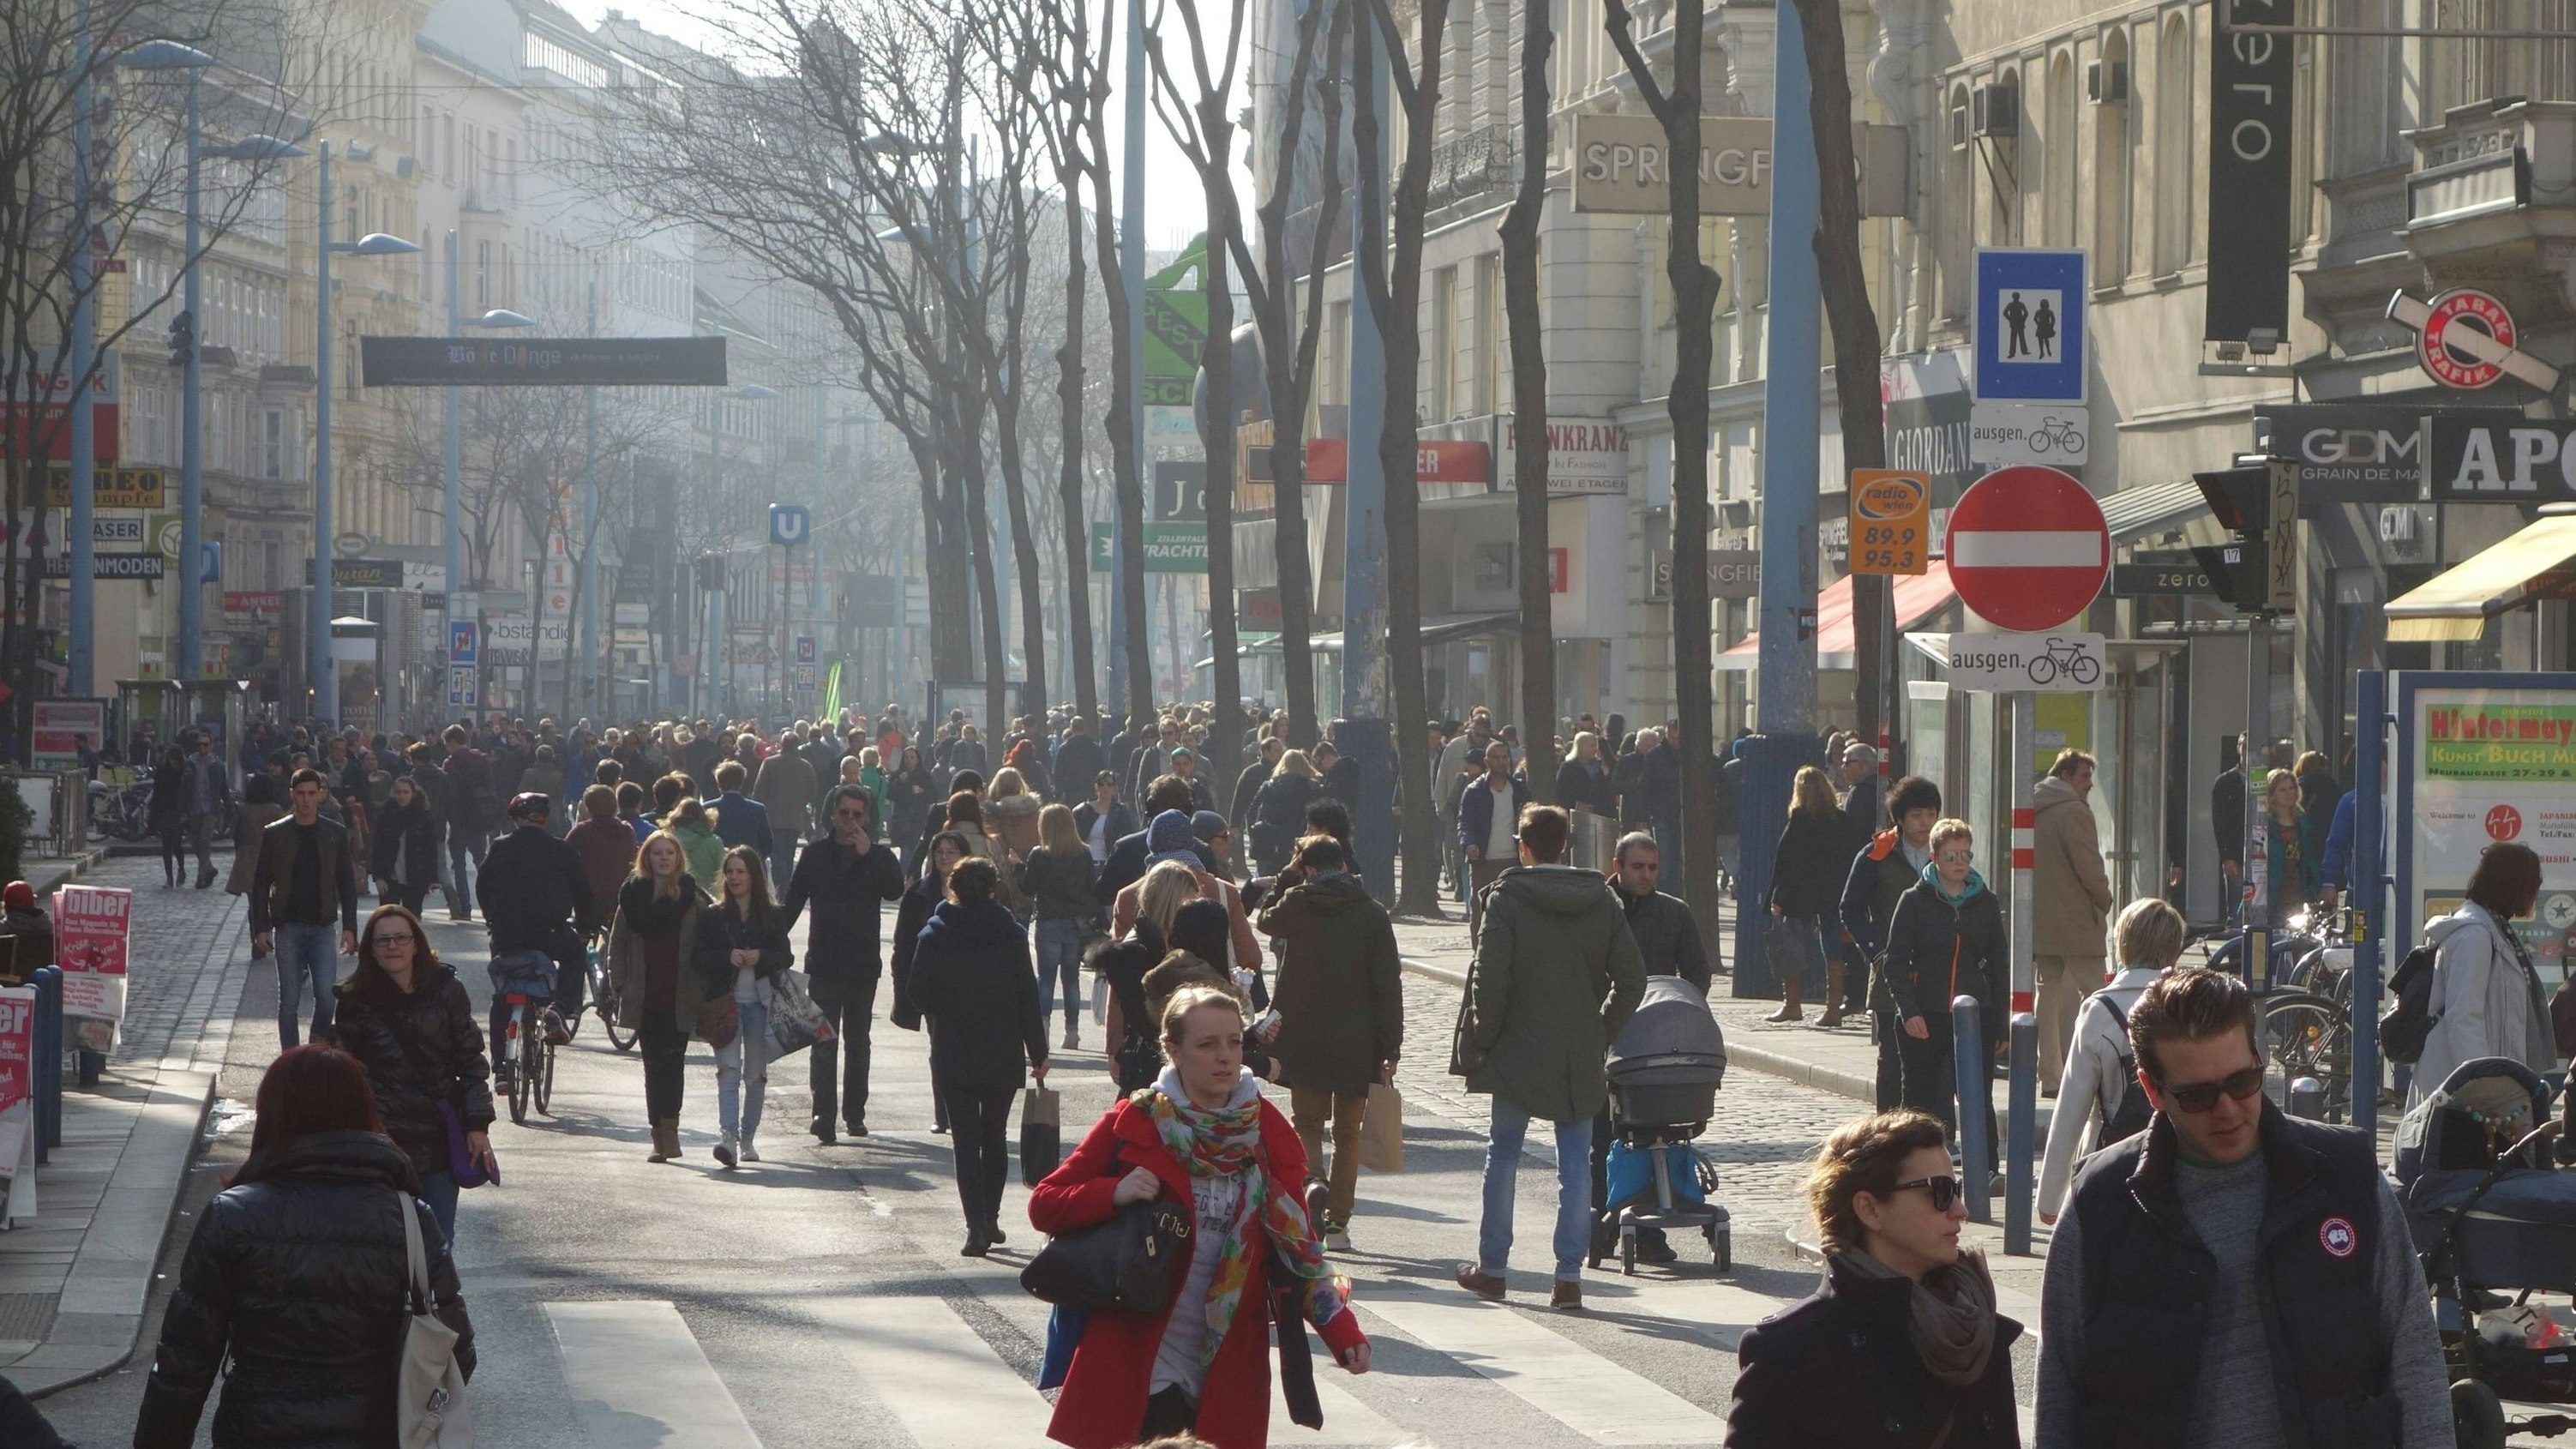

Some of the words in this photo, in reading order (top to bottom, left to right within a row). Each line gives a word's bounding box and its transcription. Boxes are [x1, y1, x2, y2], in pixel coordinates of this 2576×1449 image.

[2230, 0, 2273, 160] ero
[1586, 144, 1861, 186] SPRINGF
[2440, 297, 2510, 336] TABAK
[504, 345, 561, 369] Dnge
[2427, 332, 2489, 384] TRAFIK
[1894, 421, 1973, 475] GIORDAN
[1973, 427, 2027, 444] ausgen.
[2302, 428, 2421, 465] GDM
[1416, 448, 1438, 473] ER
[2451, 428, 2576, 491] AP
[2302, 467, 2360, 481] GRAIN
[2364, 467, 2391, 481] DE
[1865, 486, 1908, 501] radio
[1882, 501, 1913, 510] wien
[778, 514, 801, 538] U
[1864, 527, 1915, 546] 89.9
[2381, 507, 2407, 542] GDM
[1864, 550, 1914, 568] 95.3
[2158, 574, 2210, 587] zero
[1952, 652, 2026, 673] ausgen.
[2431, 708, 2576, 747] Hintermay
[2429, 811, 2465, 820] Welcome
[66, 888, 129, 917] biber
[0, 1003, 29, 1035] er
